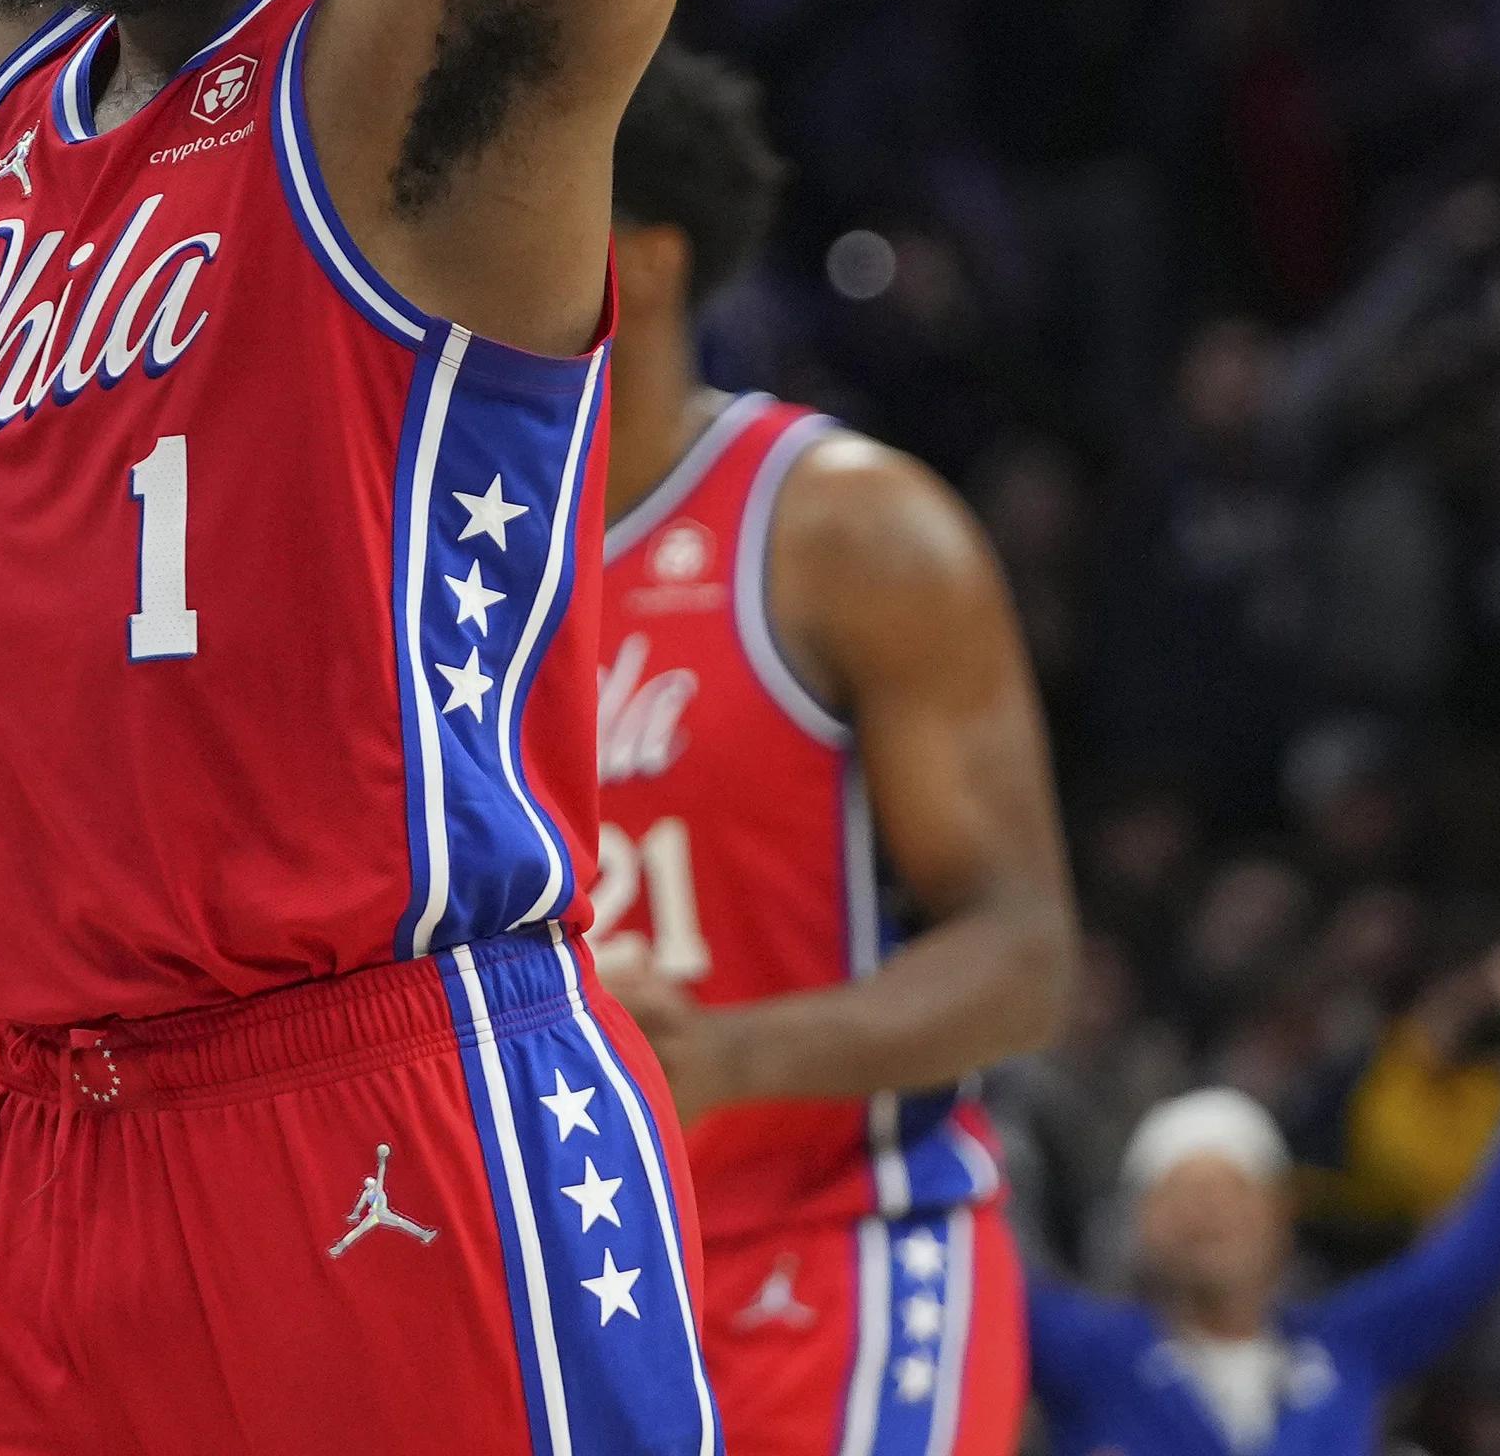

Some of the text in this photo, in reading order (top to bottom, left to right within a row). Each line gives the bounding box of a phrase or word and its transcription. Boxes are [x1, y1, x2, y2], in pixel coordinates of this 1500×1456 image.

[149, 120, 255, 164] crypto.com
[128, 434, 198, 664] 1
[583, 816, 713, 982] 21
